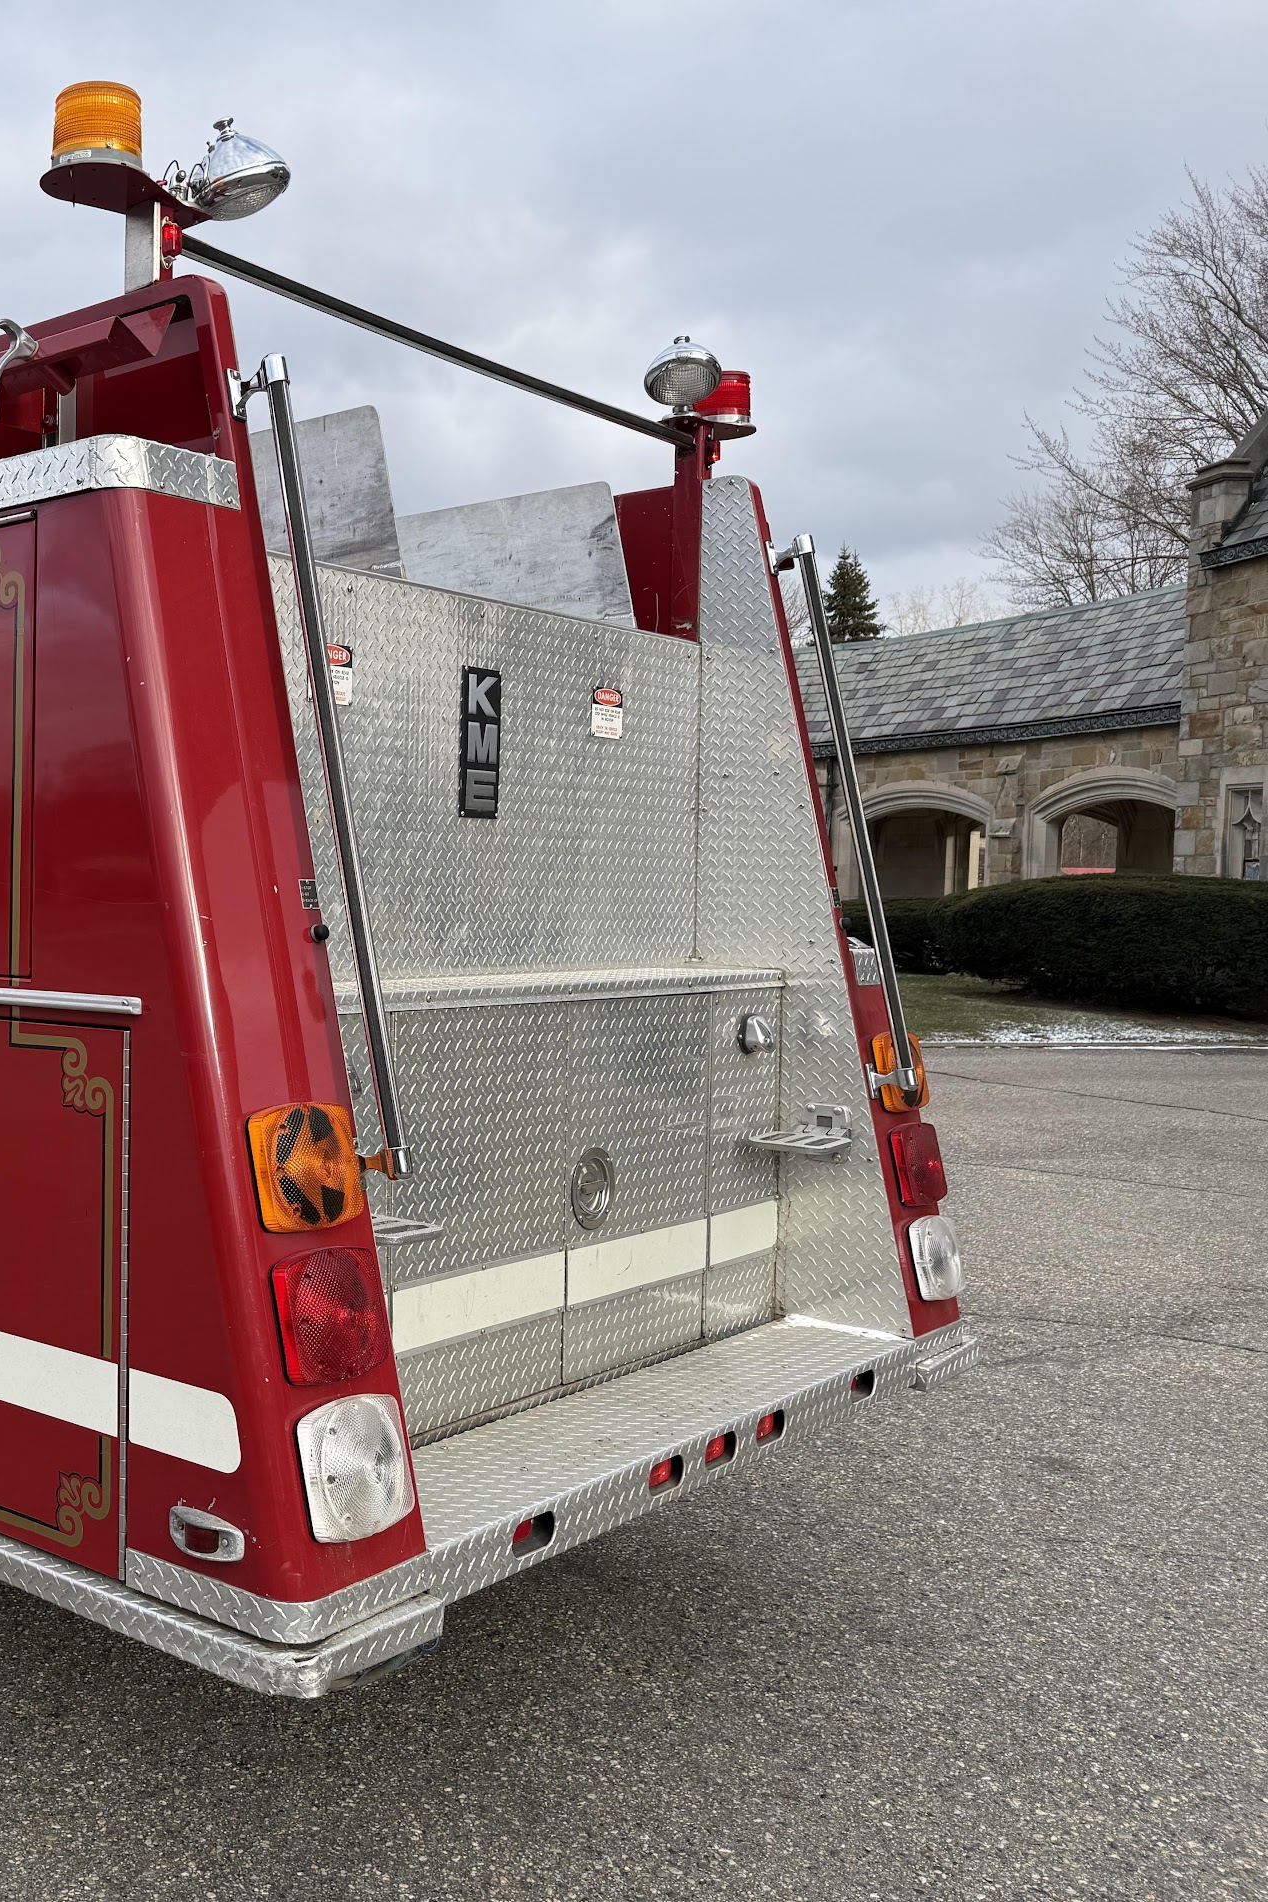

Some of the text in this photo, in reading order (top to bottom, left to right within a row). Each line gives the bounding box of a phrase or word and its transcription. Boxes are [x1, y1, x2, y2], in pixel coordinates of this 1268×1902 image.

[327, 649, 347, 661] NGER
[597, 691, 620, 703] DANGER
[465, 673, 498, 811] KME
